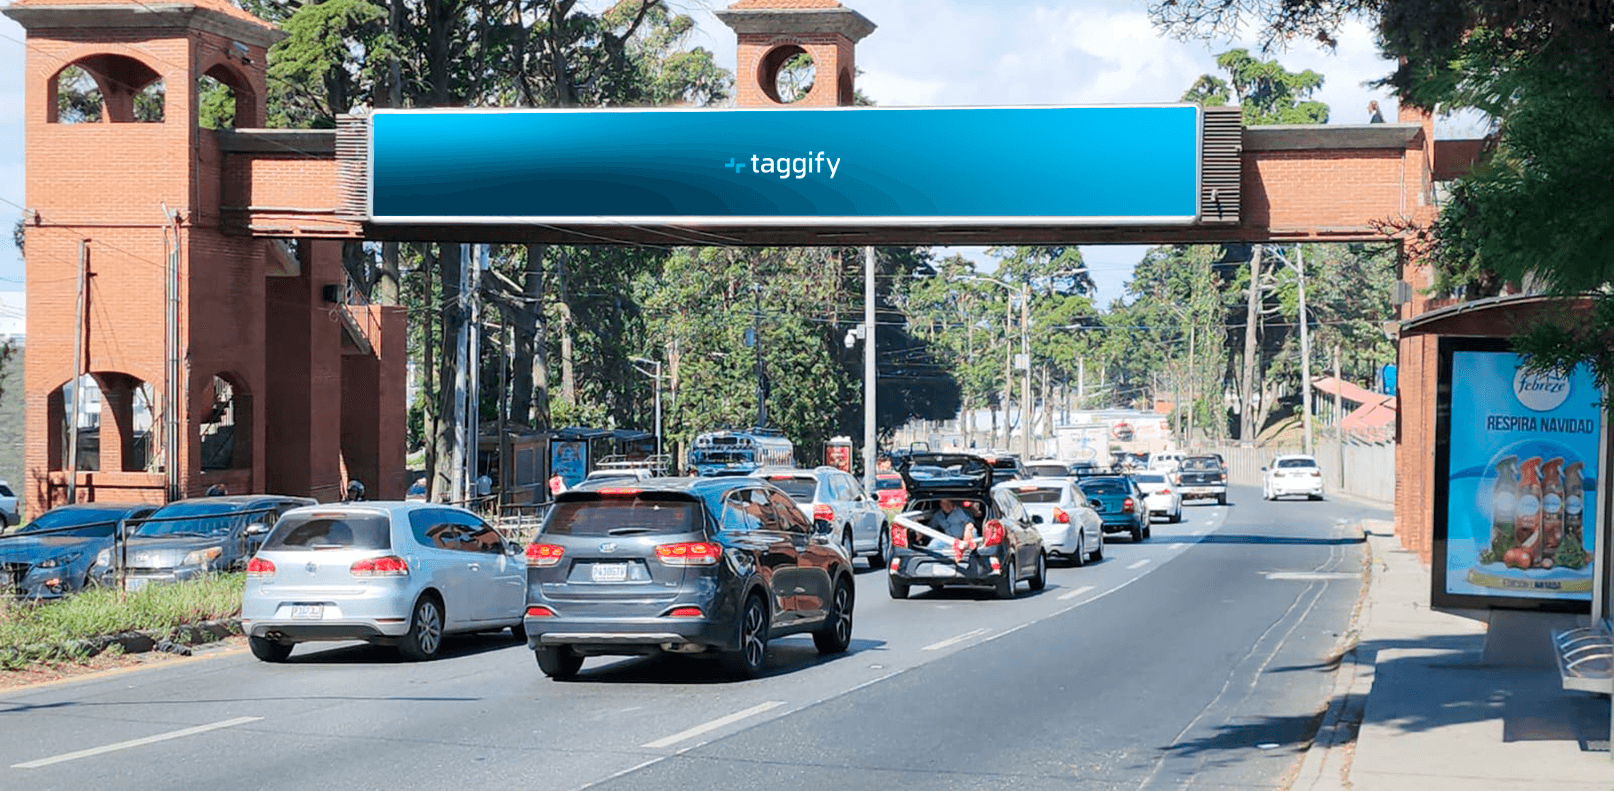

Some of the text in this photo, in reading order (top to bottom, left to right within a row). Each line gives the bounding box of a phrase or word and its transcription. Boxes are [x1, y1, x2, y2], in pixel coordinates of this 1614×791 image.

[751, 151, 841, 179] taggify
[1518, 373, 1566, 394] febreze
[1487, 415, 1594, 434] RESPIRA NAVIDAD
